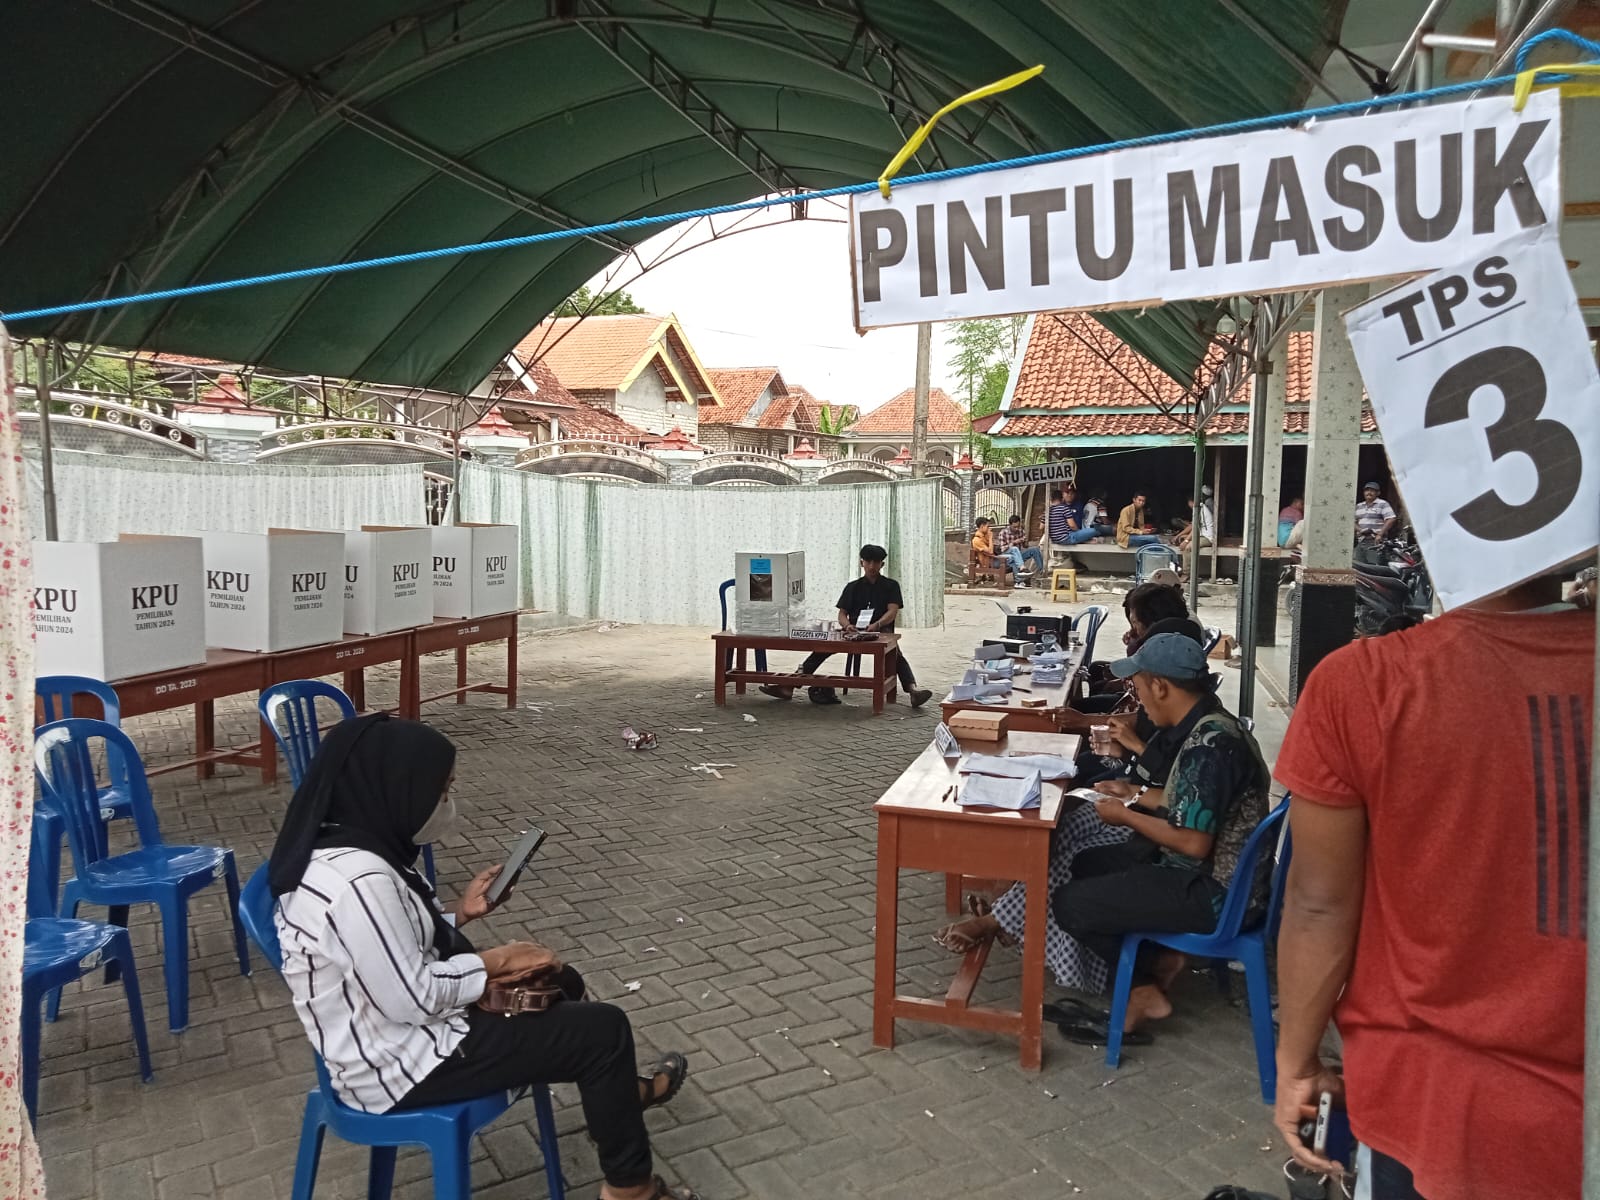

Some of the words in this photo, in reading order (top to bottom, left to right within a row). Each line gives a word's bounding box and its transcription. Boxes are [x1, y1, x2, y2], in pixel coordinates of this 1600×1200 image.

[859, 177, 1134, 303] PINTU
[1167, 118, 1552, 271] MASUK
[1382, 255, 1518, 346] TPS
[1424, 345, 1583, 542] 3
[983, 470, 1020, 486] PINTU
[1023, 464, 1073, 483] KELUAR
[392, 562, 420, 582] KPU
[432, 556, 456, 573] PU
[485, 555, 508, 572] KPU
[206, 570, 250, 593] KPU
[292, 572, 327, 593] KPU
[131, 583, 179, 610] KPU
[55, 625, 74, 635] 2024
